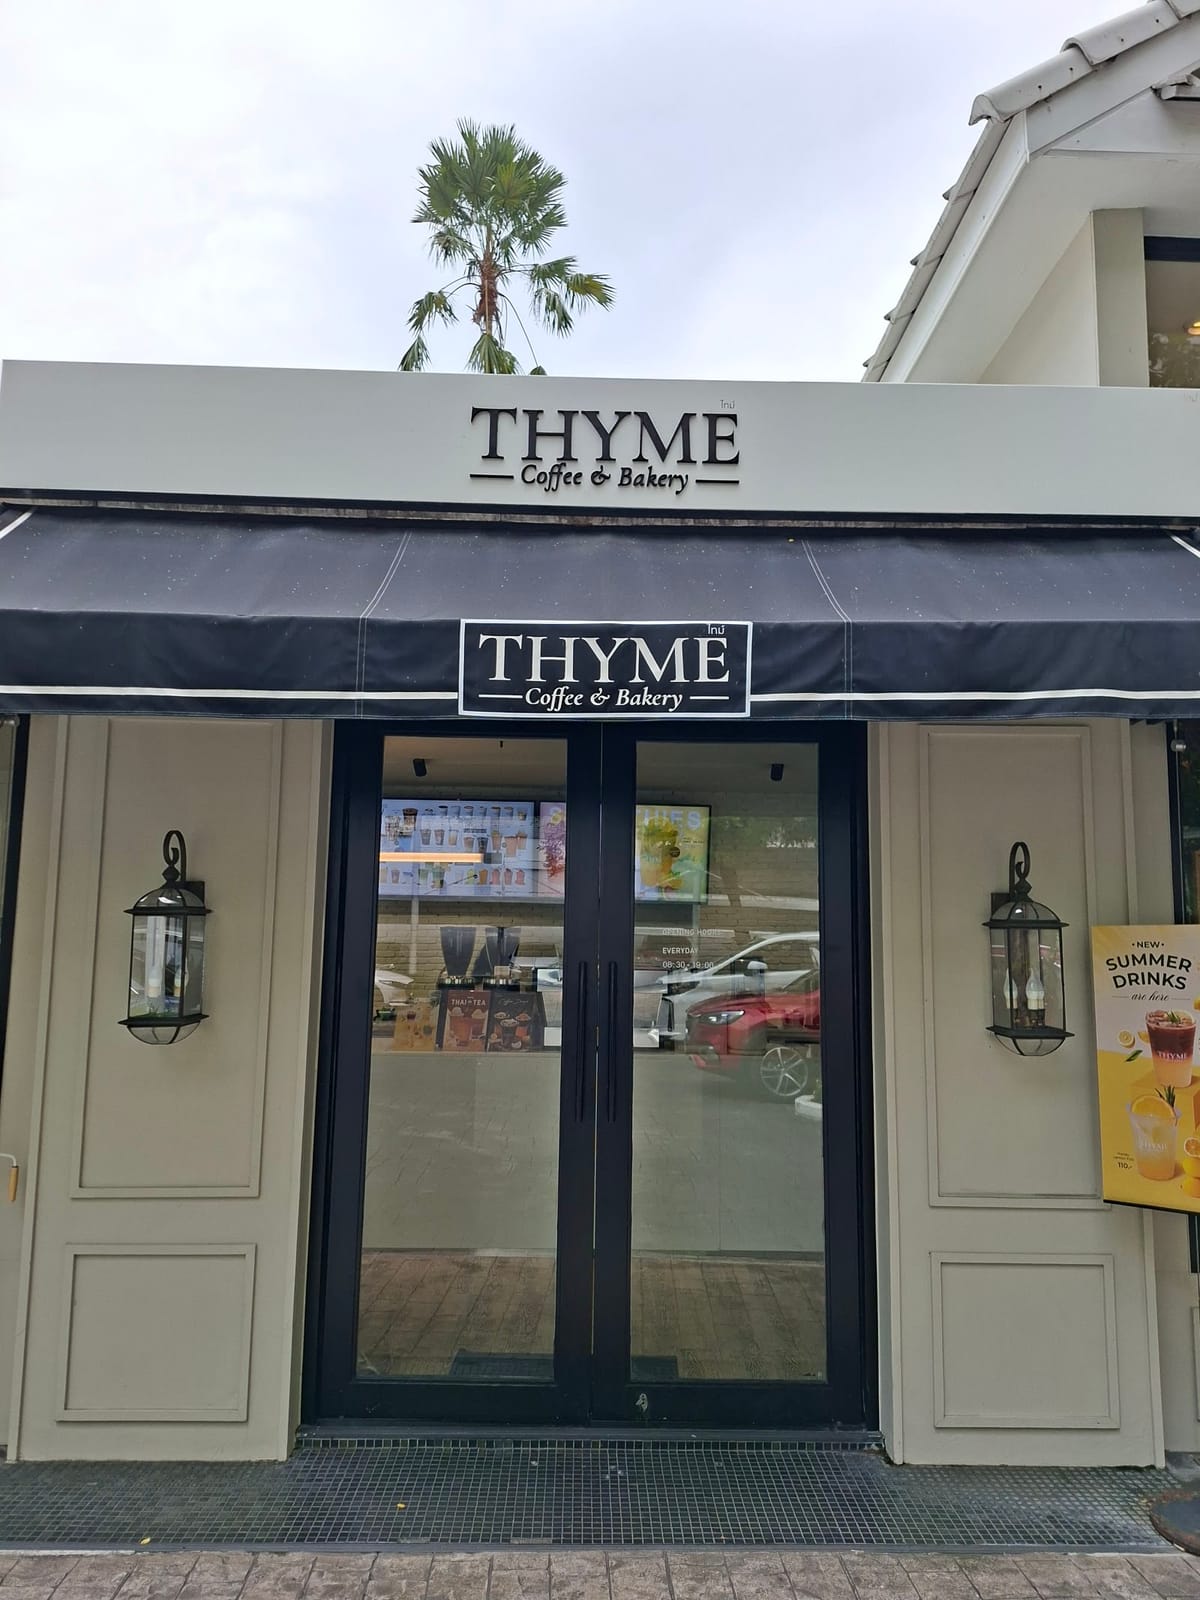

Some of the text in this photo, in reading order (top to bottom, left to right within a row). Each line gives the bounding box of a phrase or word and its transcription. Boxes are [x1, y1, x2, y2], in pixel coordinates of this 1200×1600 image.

[471, 406, 740, 465] THYME
[521, 463, 689, 494] Coffee & Bakery
[478, 634, 730, 683] THYME
[525, 686, 683, 712] Coffee & Bakery
[1105, 952, 1192, 973] SUMMER
[1112, 971, 1187, 990] DRINKS
[1131, 990, 1170, 1001] are here
